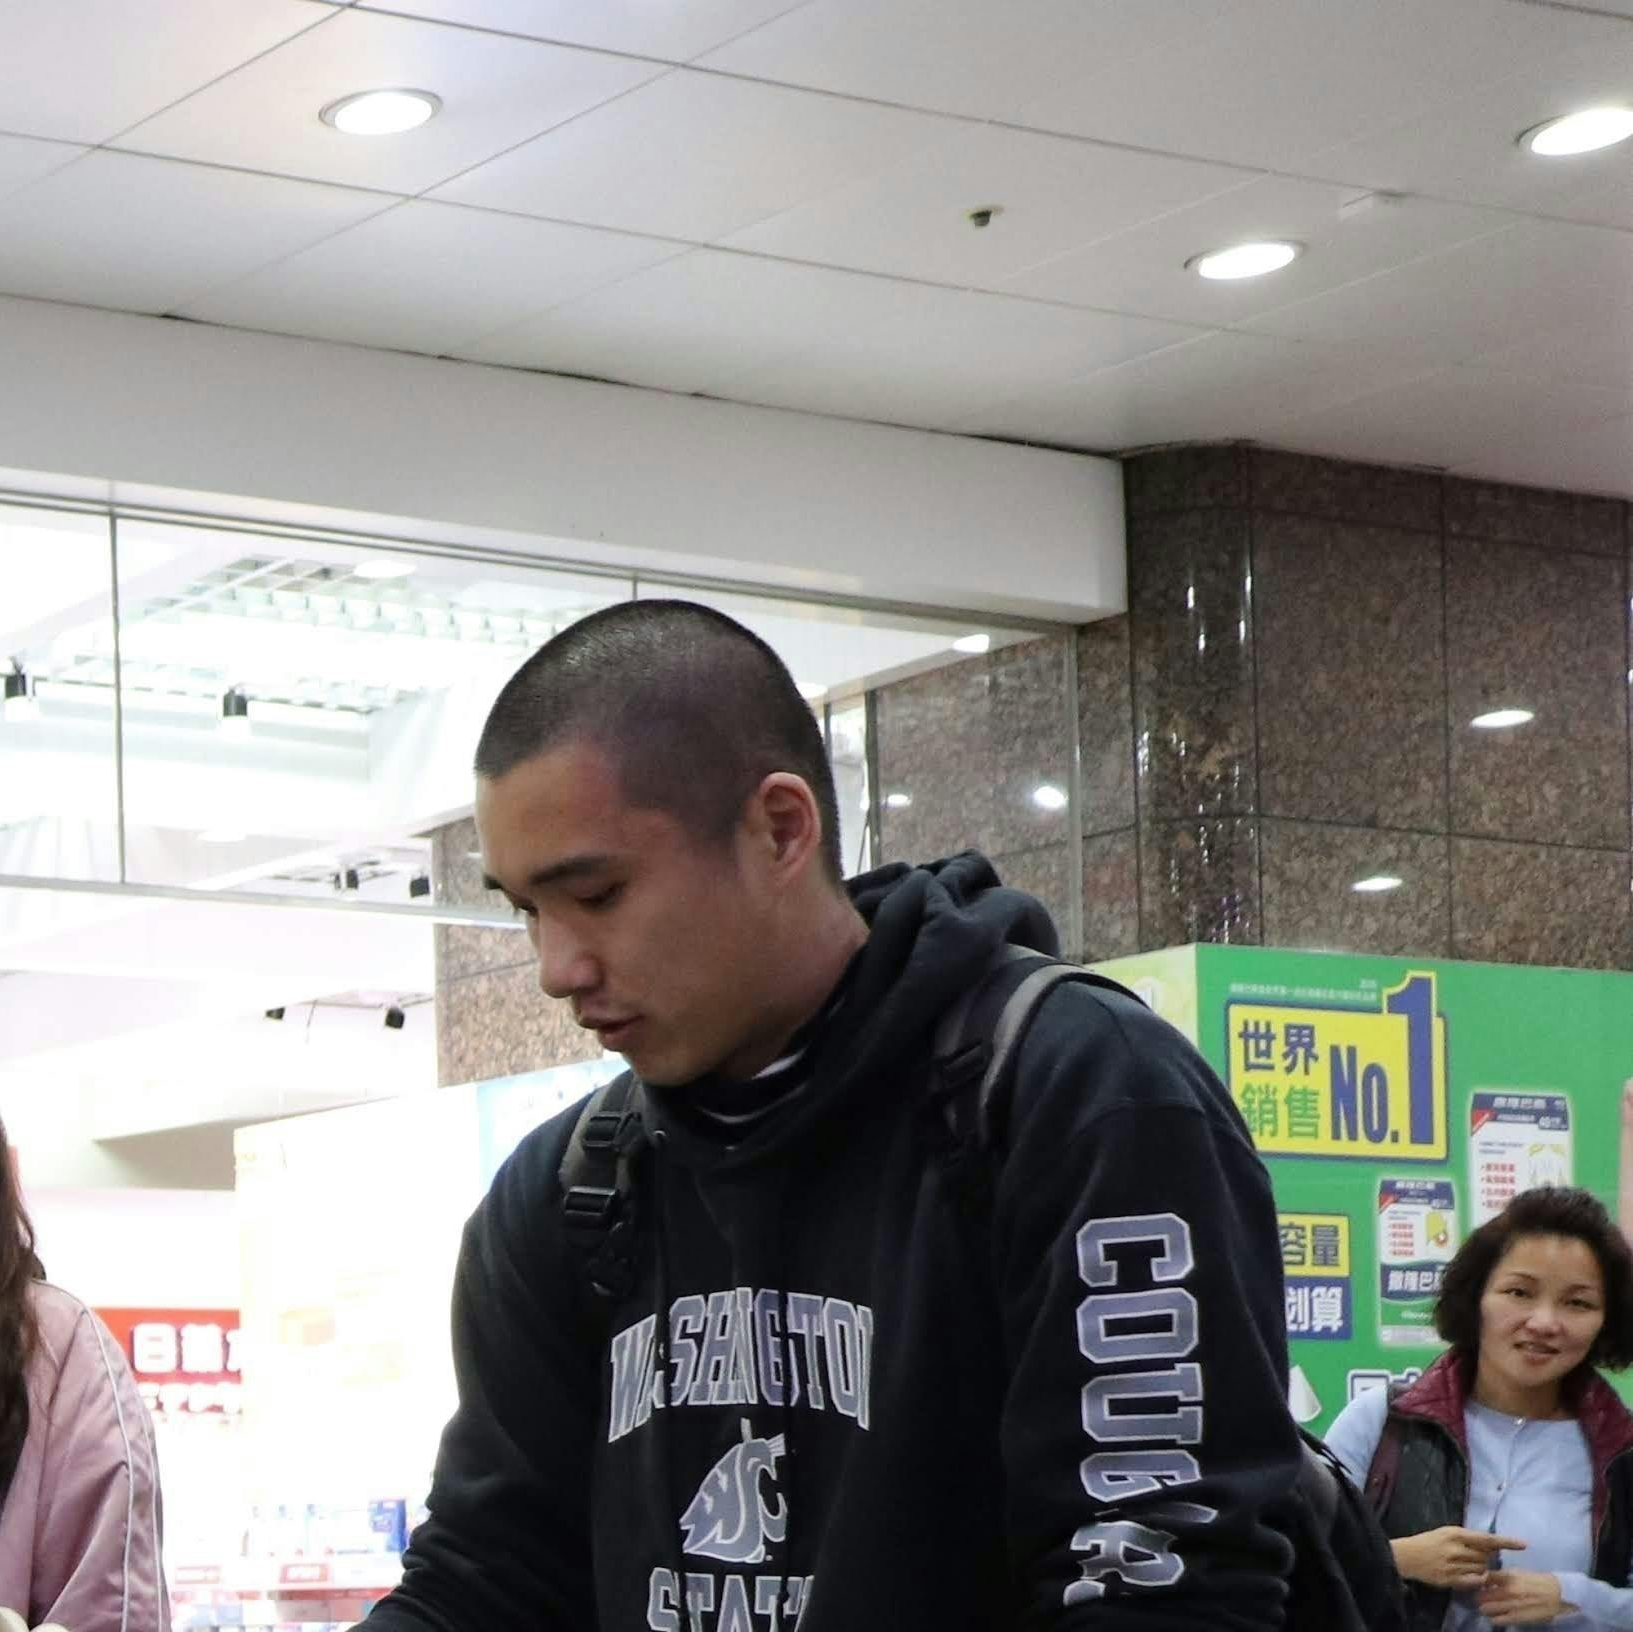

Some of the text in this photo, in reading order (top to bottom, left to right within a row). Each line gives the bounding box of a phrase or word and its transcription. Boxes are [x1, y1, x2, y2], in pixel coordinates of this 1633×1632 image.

[1239, 1020, 1319, 1076] 世界
[1329, 976, 1435, 1145] No.1
[1240, 1083, 1320, 1141] 銷售
